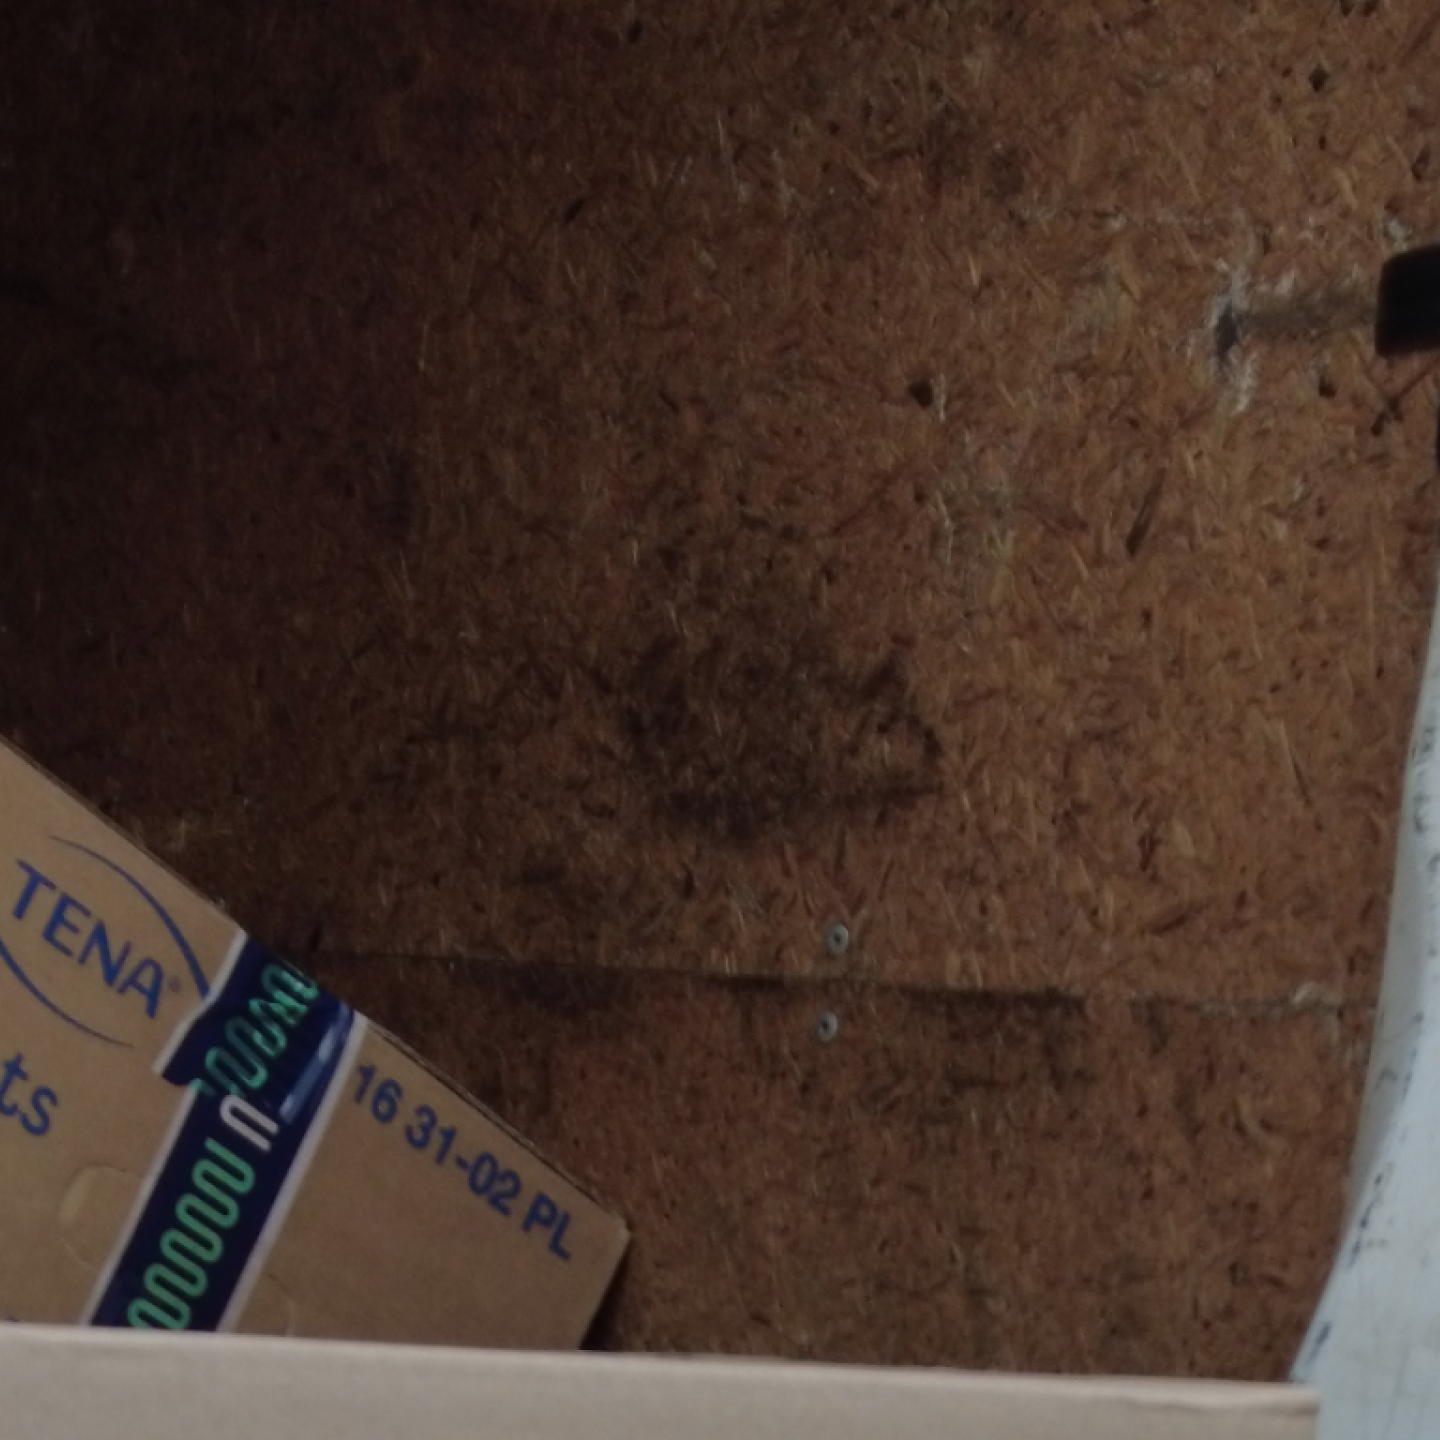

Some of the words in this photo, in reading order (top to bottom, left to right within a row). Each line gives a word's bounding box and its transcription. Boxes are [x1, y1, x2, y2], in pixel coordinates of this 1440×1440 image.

[11, 859, 165, 1019] TENA
[354, 1064, 403, 1124] 16
[405, 1104, 522, 1217] 31-02
[522, 1191, 571, 1262] PL
